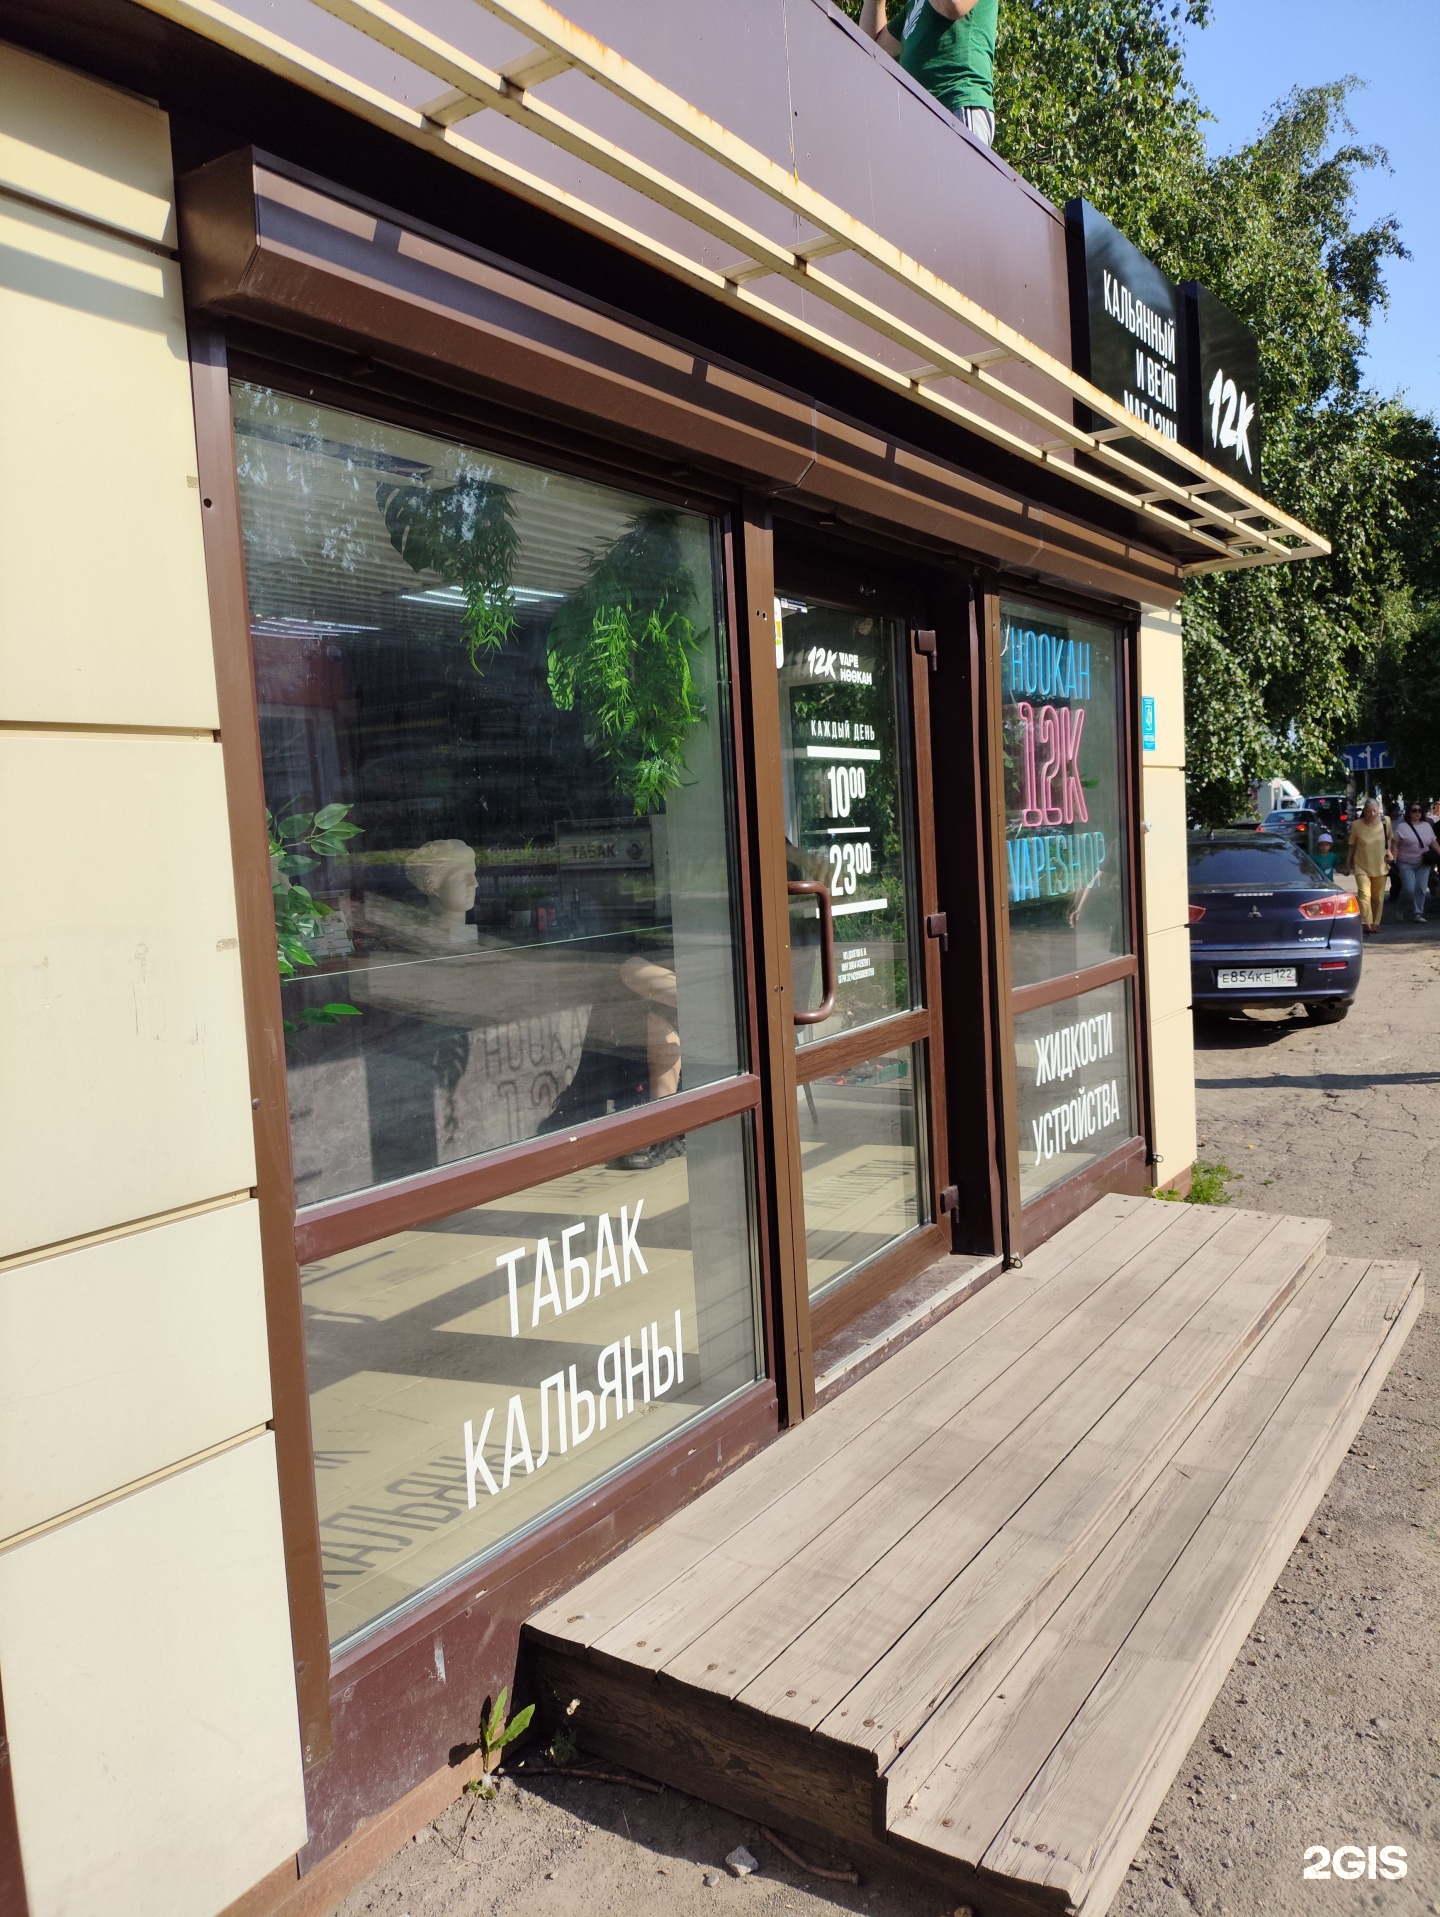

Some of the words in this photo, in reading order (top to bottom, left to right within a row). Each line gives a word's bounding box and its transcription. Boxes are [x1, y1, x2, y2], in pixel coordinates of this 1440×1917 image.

[1103, 269, 1176, 364] КАЛЬЯННЫЙ
[1135, 348, 1145, 391] И
[1146, 356, 1177, 413] ВЕЙП
[1208, 368, 1255, 475] 12K
[807, 645, 839, 681] 12K
[838, 651, 860, 669] VAPE
[839, 667, 873, 686] HOOKAH
[1010, 626, 1091, 700] HOOKAH
[810, 719, 851, 740] КАЖДЫЙ
[853, 722, 876, 742] ДЕНЬ
[1017, 701, 1089, 827] 12K
[1034, 1011, 1113, 1087] ЖИДКОСТИ
[1032, 1079, 1120, 1167] УСТРОЙСТВА
[496, 1198, 649, 1338] ТАБАК
[464, 1309, 685, 1511] КАЛЬЯНЫ
